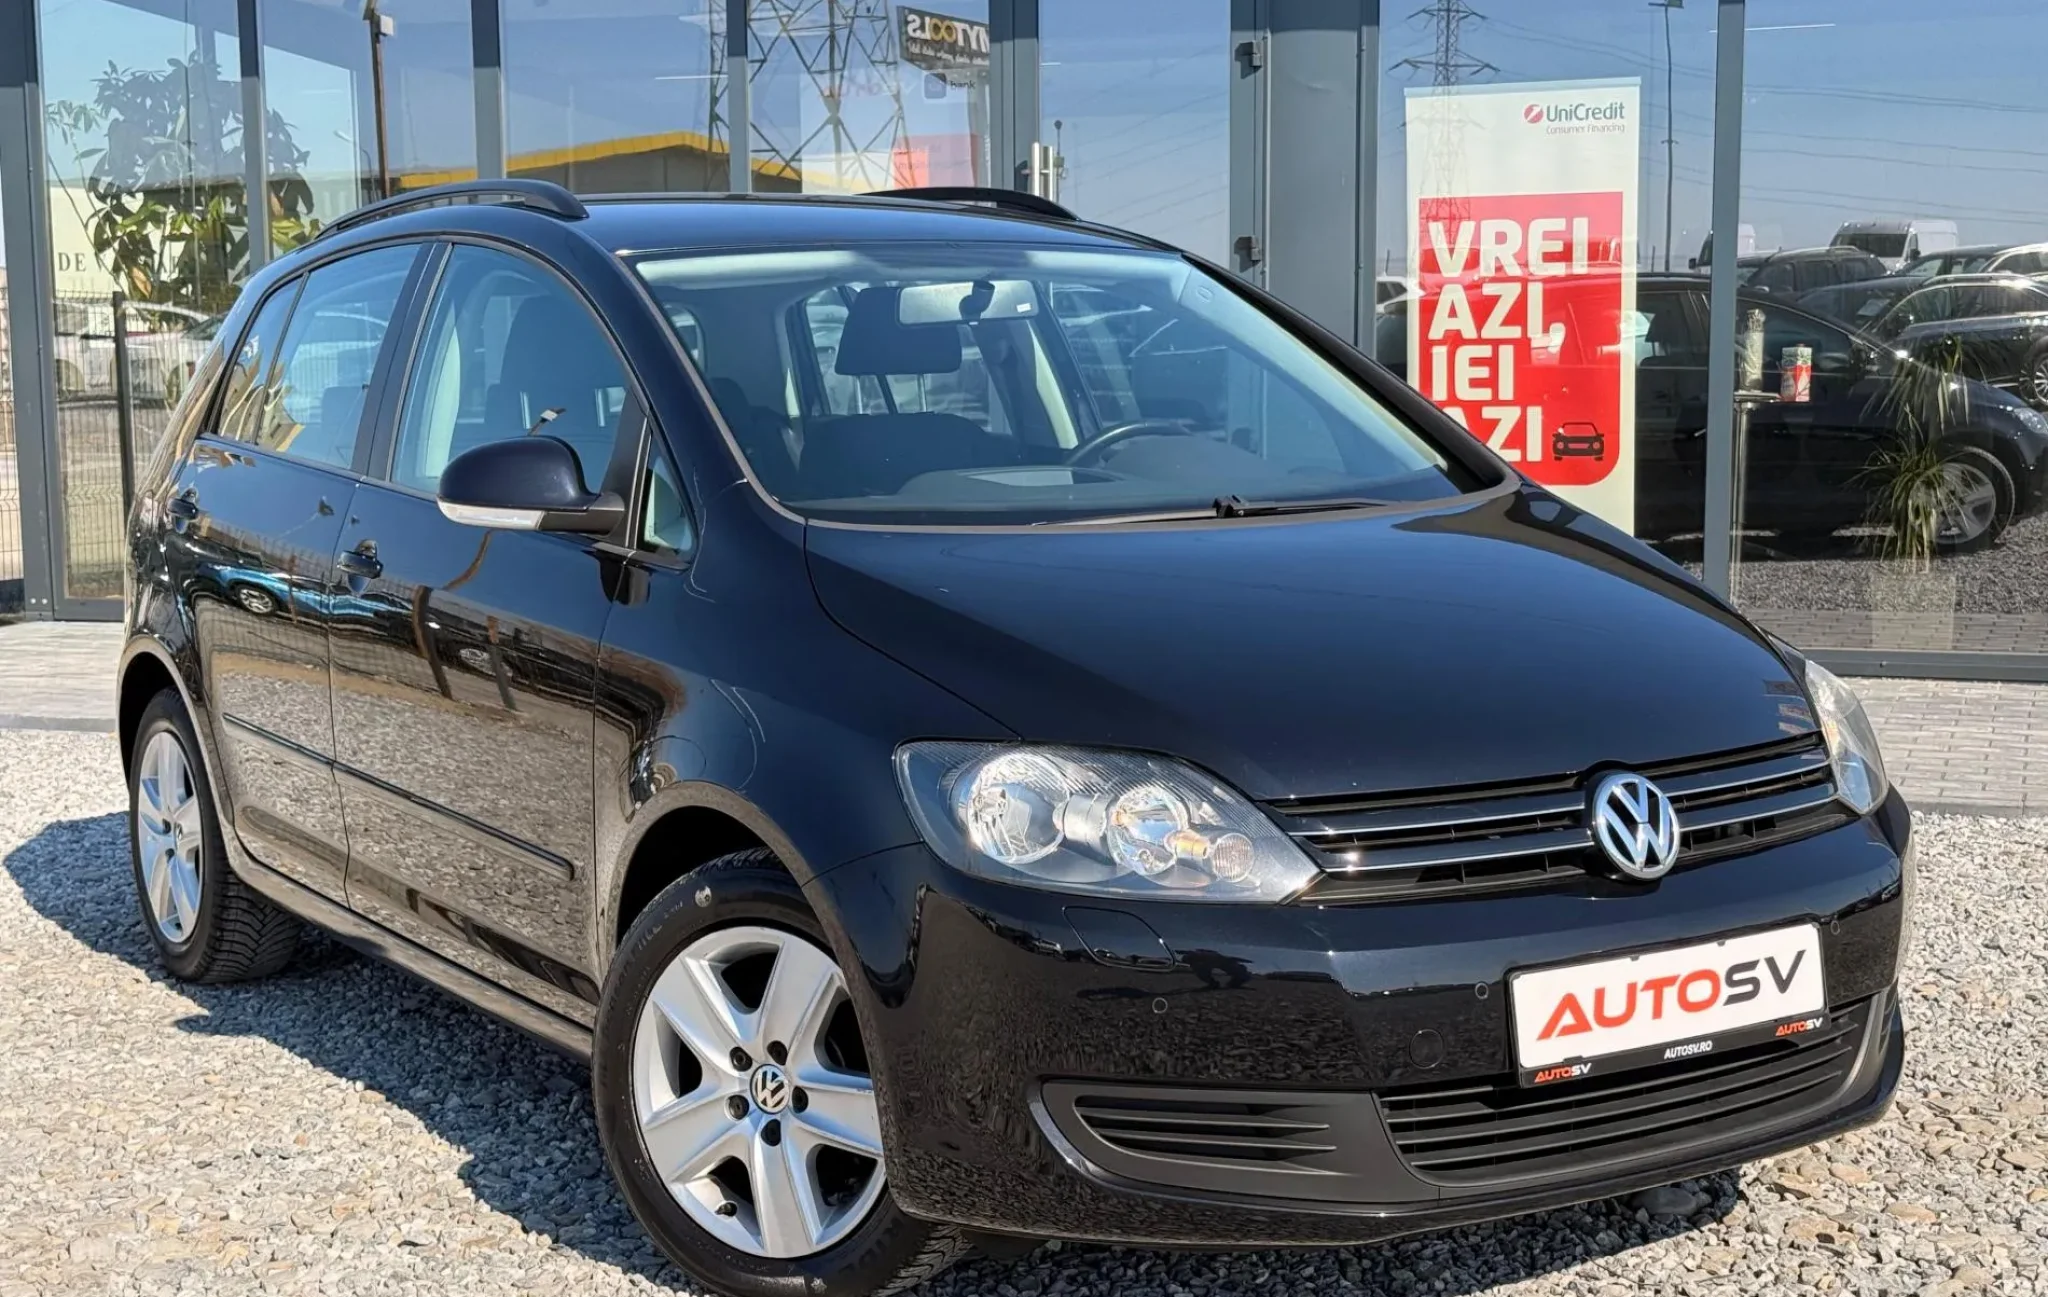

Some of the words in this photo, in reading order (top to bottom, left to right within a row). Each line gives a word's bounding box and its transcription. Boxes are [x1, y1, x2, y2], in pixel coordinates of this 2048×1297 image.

[1546, 101, 1625, 122] UniCredit
[1546, 124, 1585, 135] Consumer
[1587, 122, 1625, 133] Financing
[1428, 217, 1589, 278] VREI
[58, 252, 87, 272] DE
[1428, 281, 1566, 353] AZI,
[1432, 344, 1515, 401] IEI
[1536, 949, 1807, 1041] AUTOSV
[1774, 1017, 1823, 1037] AUTOSV
[1664, 1040, 1713, 1060] AUTOSV.RO
[1534, 1062, 1592, 1084] AUTOSV
